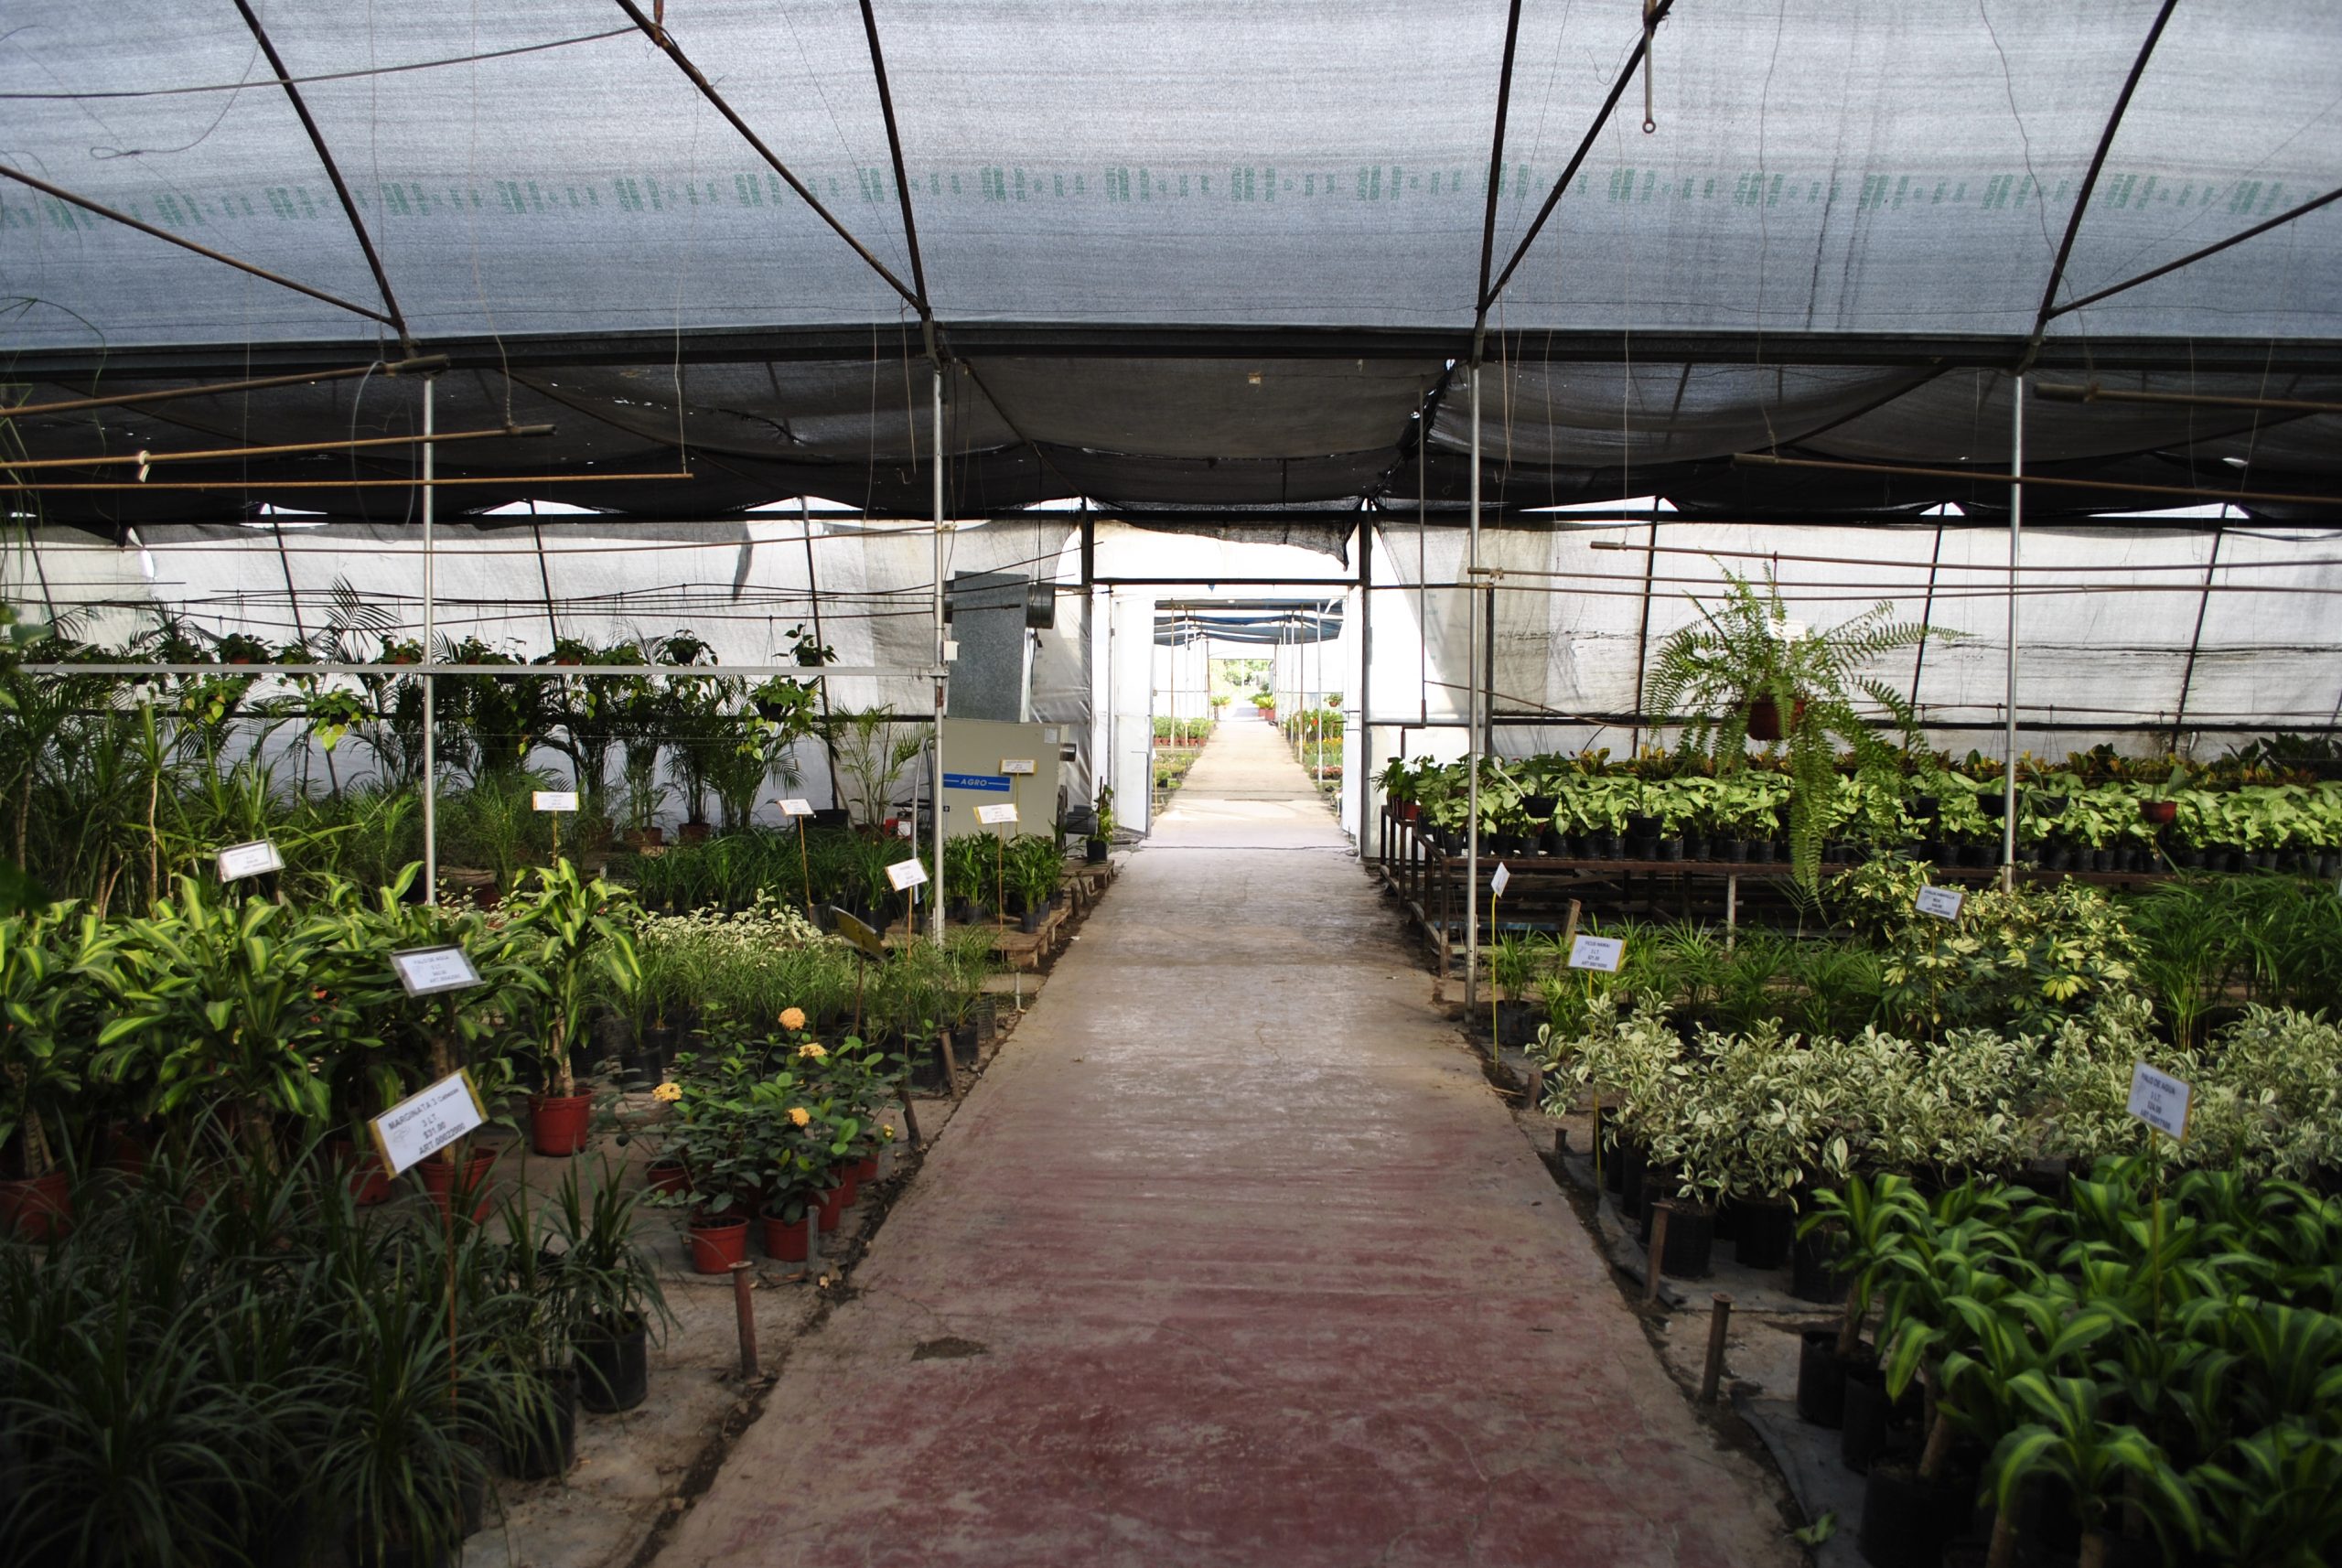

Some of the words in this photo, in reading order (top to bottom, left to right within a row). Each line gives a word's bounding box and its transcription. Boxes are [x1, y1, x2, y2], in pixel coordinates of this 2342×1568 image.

[961, 778, 987, 787] AGRO
[2142, 1072, 2153, 1085] PALO
[2154, 1078, 2161, 1088] DE
[2161, 1083, 2175, 1095] AGUA
[388, 1101, 431, 1130] MARGINATA
[424, 1121, 446, 1139] $31.00
